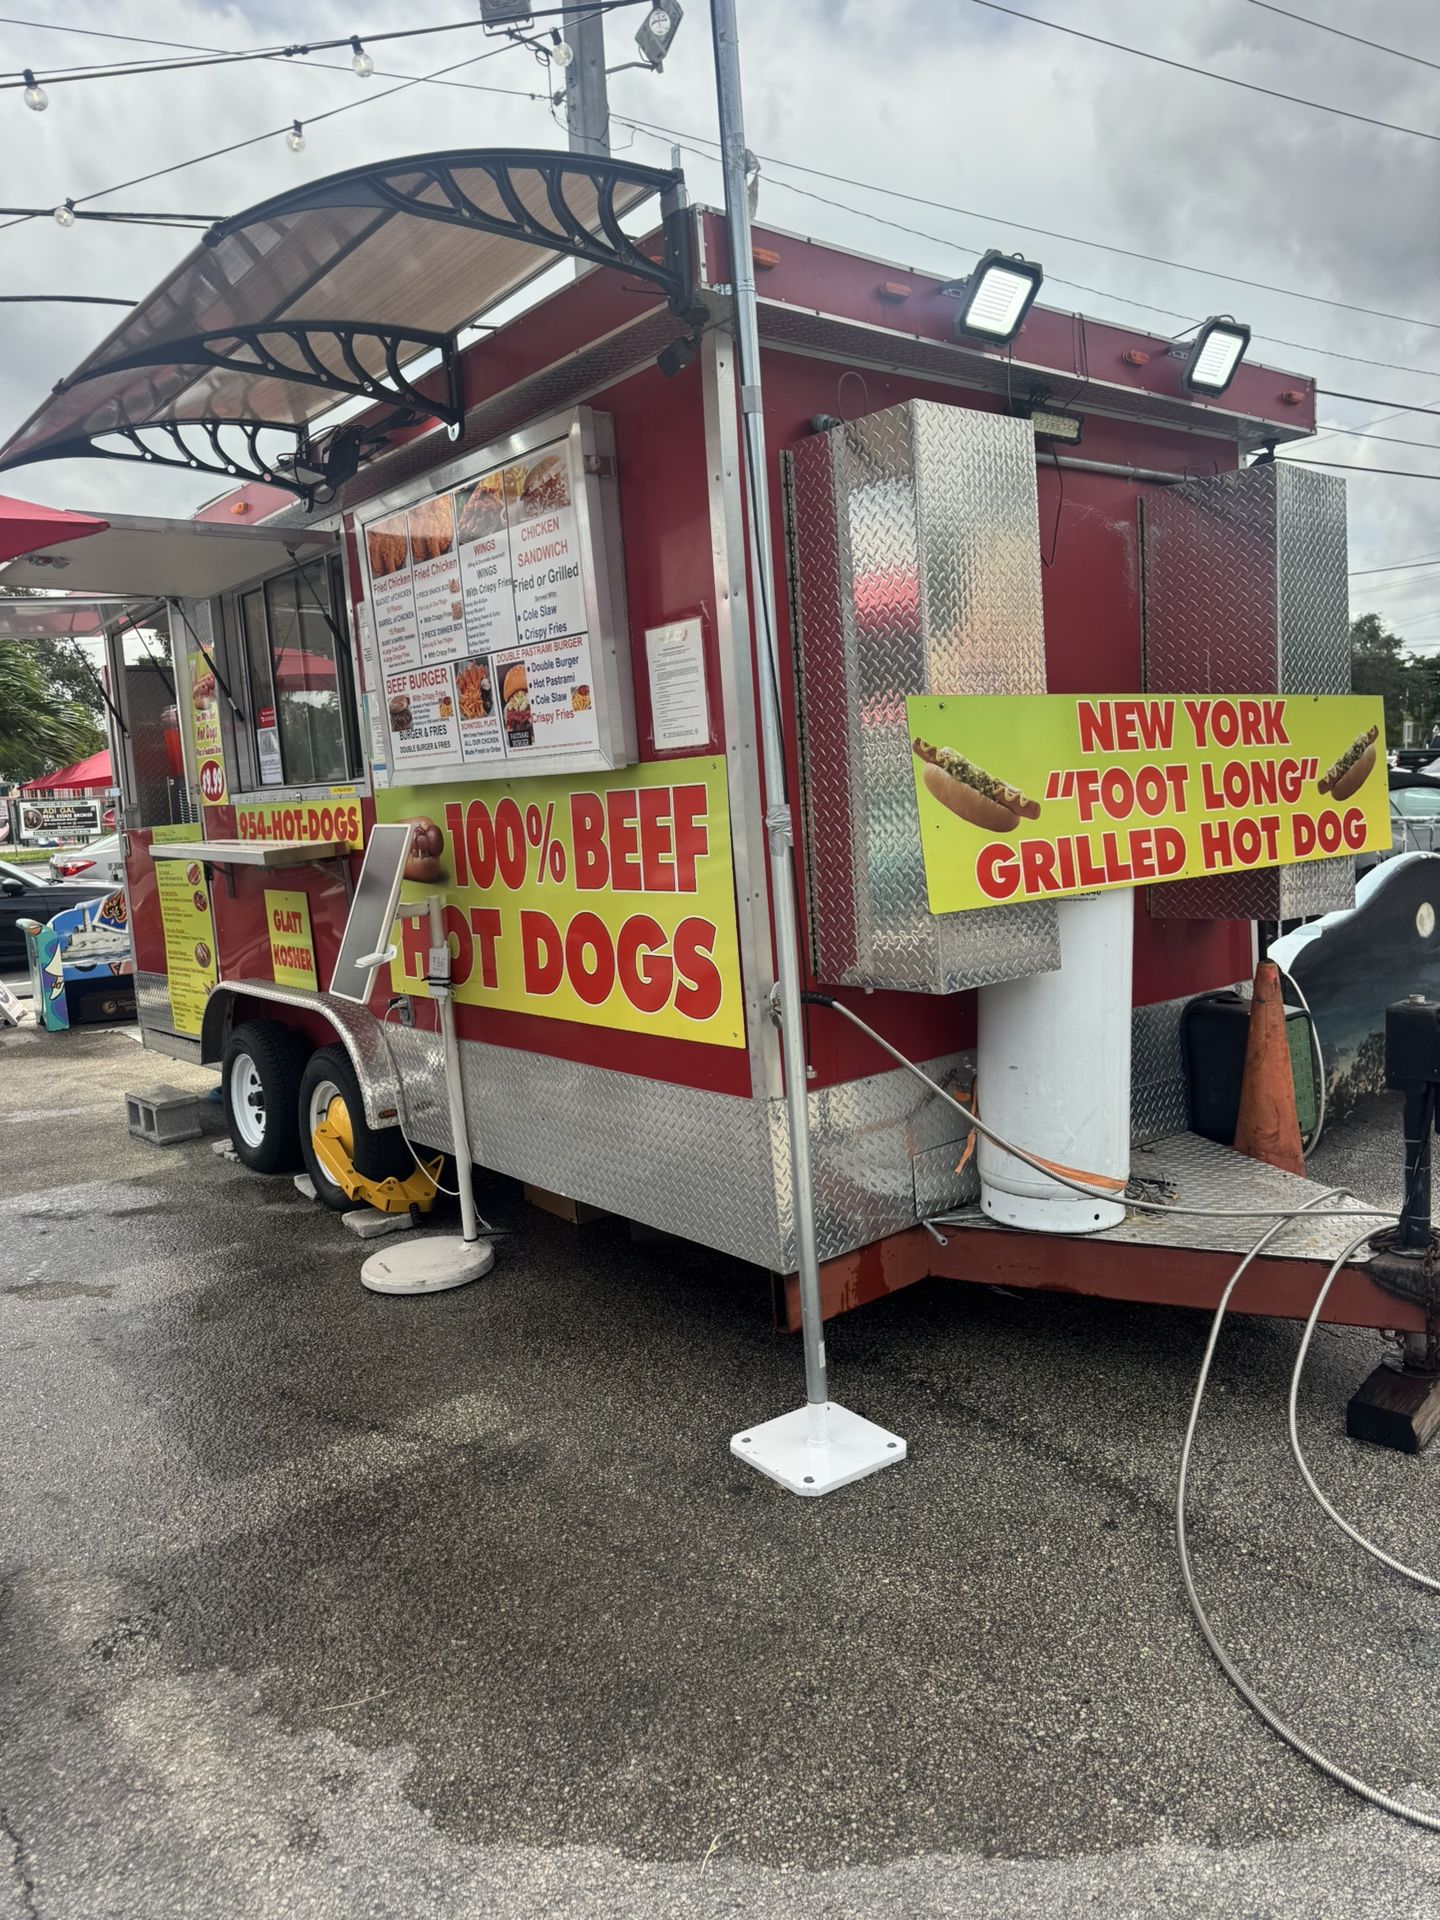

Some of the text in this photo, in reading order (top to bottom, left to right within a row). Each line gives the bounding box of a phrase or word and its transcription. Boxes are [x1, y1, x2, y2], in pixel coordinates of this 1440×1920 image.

[521, 516, 560, 542] CHICKEN
[473, 539, 496, 555] WINGS
[518, 539, 568, 567] SANDWICH
[414, 559, 457, 581] Fried Chicken
[477, 564, 497, 579] WINGS
[512, 562, 579, 594] Fried or Grilled
[373, 575, 411, 592] Fried Chicken
[466, 574, 514, 598] With Crispy Fries
[376, 595, 390, 607] BUCKET
[394, 589, 412, 600] CHICKEN
[378, 618, 393, 628] BARREL
[396, 611, 414, 622] CHICKEN
[523, 605, 557, 621] Cole Slaw
[424, 629, 436, 638] PIECE
[437, 625, 453, 635] DINNER
[453, 623, 463, 631] BOX
[525, 622, 567, 640] Crispy Fries
[497, 637, 583, 663] DOUBLE PASTRAMI BURGER
[531, 656, 579, 672] Double Burger
[387, 668, 448, 694] BEEF BURGER
[533, 672, 575, 688] Hot Pastrami
[435, 690, 446, 698] Fries
[535, 692, 567, 705] Cole Slaw
[483, 719, 497, 727] PLATE
[530, 708, 575, 726] Crispy Fries
[1076, 699, 1291, 753] NEW YORK
[399, 724, 447, 741] BURGER & FRIES
[400, 745, 416, 754] DOUBLE
[416, 743, 433, 752] BURGER
[436, 740, 451, 749] FRIES
[202, 767, 223, 795] $9.99
[239, 807, 359, 841] 954-HOT-DOGS
[445, 783, 710, 893] 100% BEEF
[974, 806, 1367, 901] GRILLED HOT DOG
[273, 908, 303, 935] GLATT
[273, 943, 314, 973] KOSHER
[401, 904, 722, 1021] HOT DOGS
